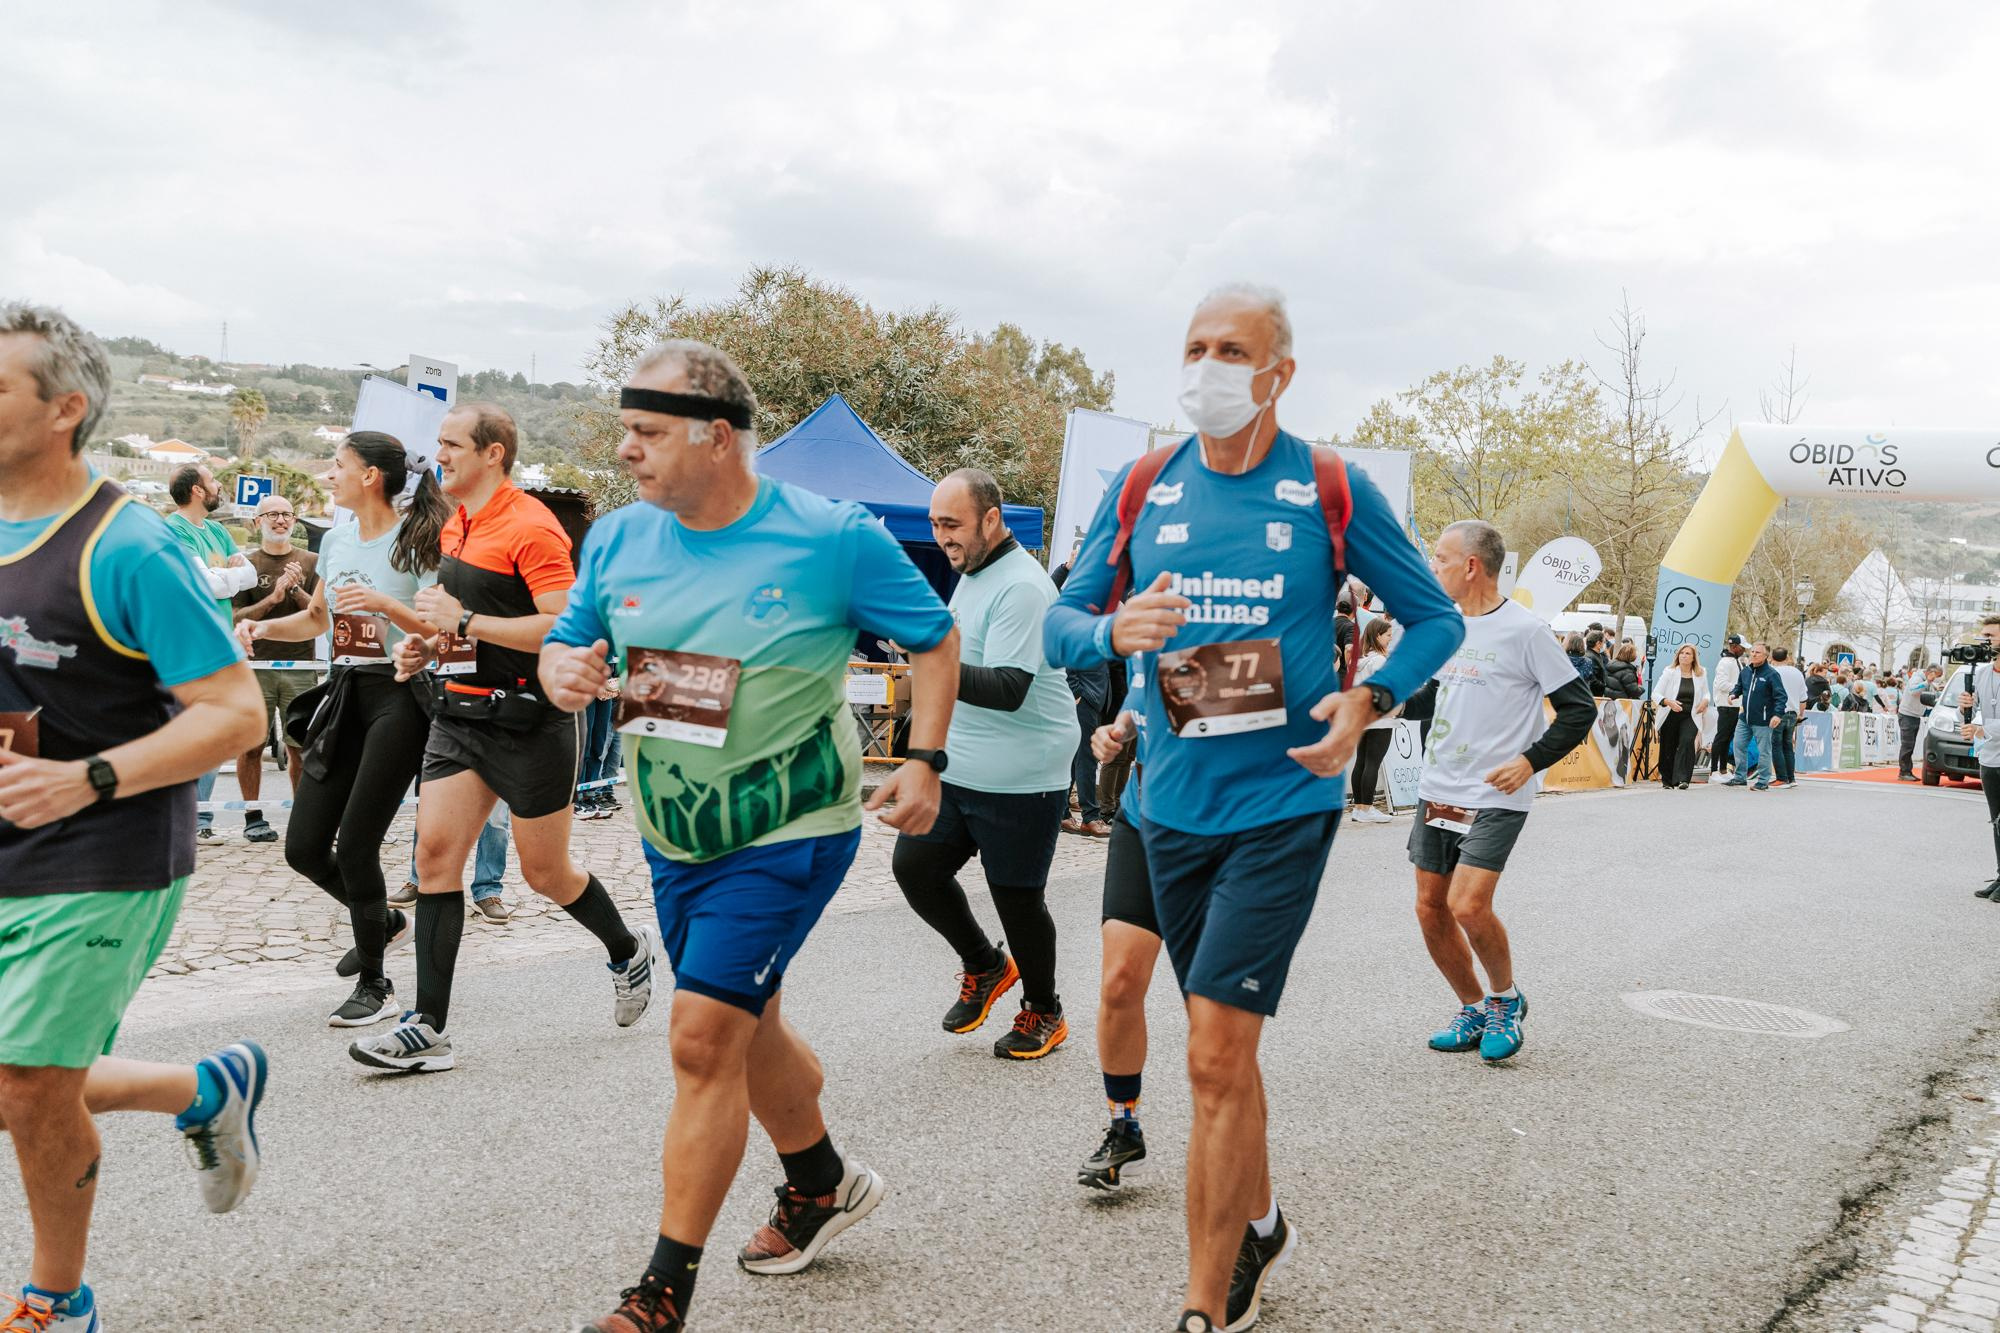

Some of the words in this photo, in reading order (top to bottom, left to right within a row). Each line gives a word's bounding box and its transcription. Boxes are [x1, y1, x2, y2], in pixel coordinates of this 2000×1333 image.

[425, 366, 442, 377] zona
[1828, 467, 1907, 488] ATIVO
[242, 480, 259, 503] P
[1555, 569, 1590, 584] ATIVO
[360, 623, 376, 639] 10
[1223, 652, 1260, 680] 77
[675, 664, 729, 694] 238
